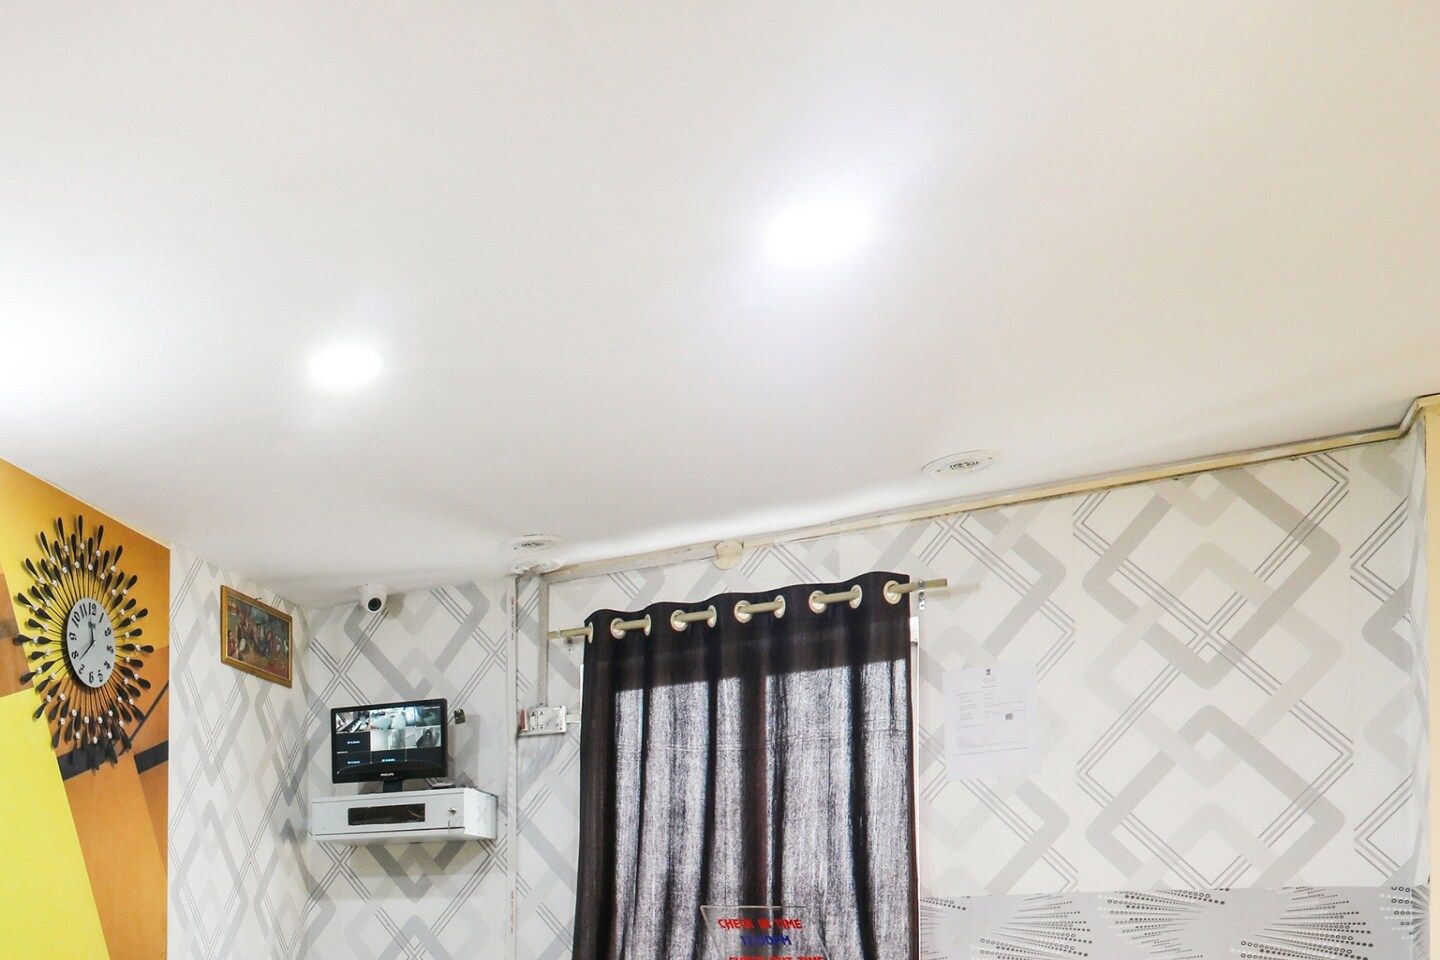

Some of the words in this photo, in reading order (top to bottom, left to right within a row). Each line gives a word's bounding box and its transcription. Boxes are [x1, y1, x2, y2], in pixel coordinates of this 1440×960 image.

[79, 603, 87, 618] 11
[88, 602, 97, 616] 12
[71, 611, 80, 628] 10
[99, 612, 104, 623] 1
[88, 671, 94, 683] 6
